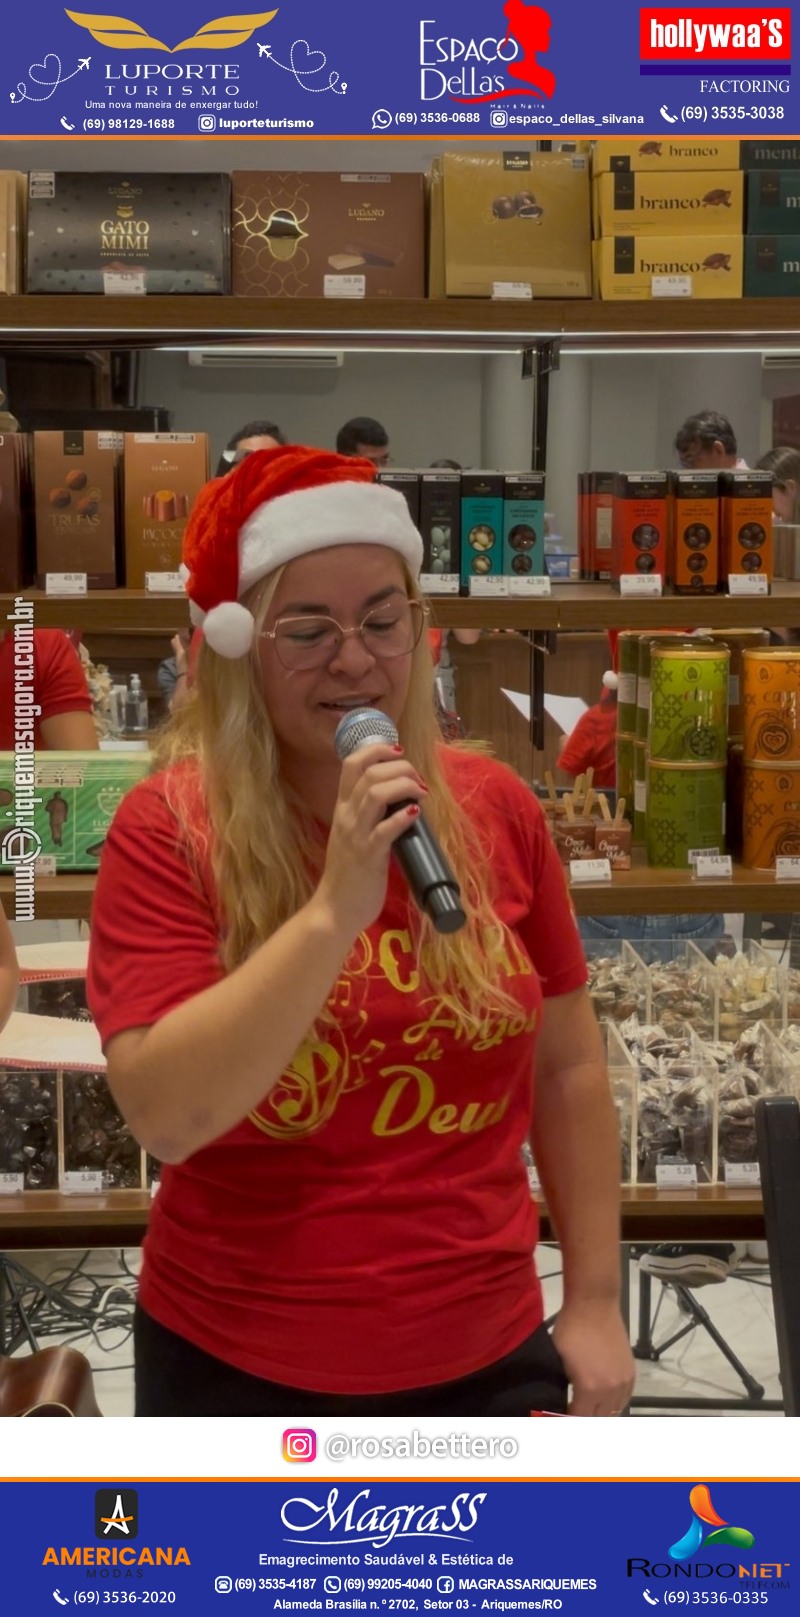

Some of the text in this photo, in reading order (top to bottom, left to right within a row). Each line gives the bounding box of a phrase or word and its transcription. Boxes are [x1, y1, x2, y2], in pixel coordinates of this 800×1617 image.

[669, 144, 718, 157] branco
[640, 196, 700, 210] branco
[348, 208, 385, 217] LUGANO
[100, 219, 150, 235] GATO
[101, 235, 149, 250] MIMI
[640, 259, 701, 273] branco
